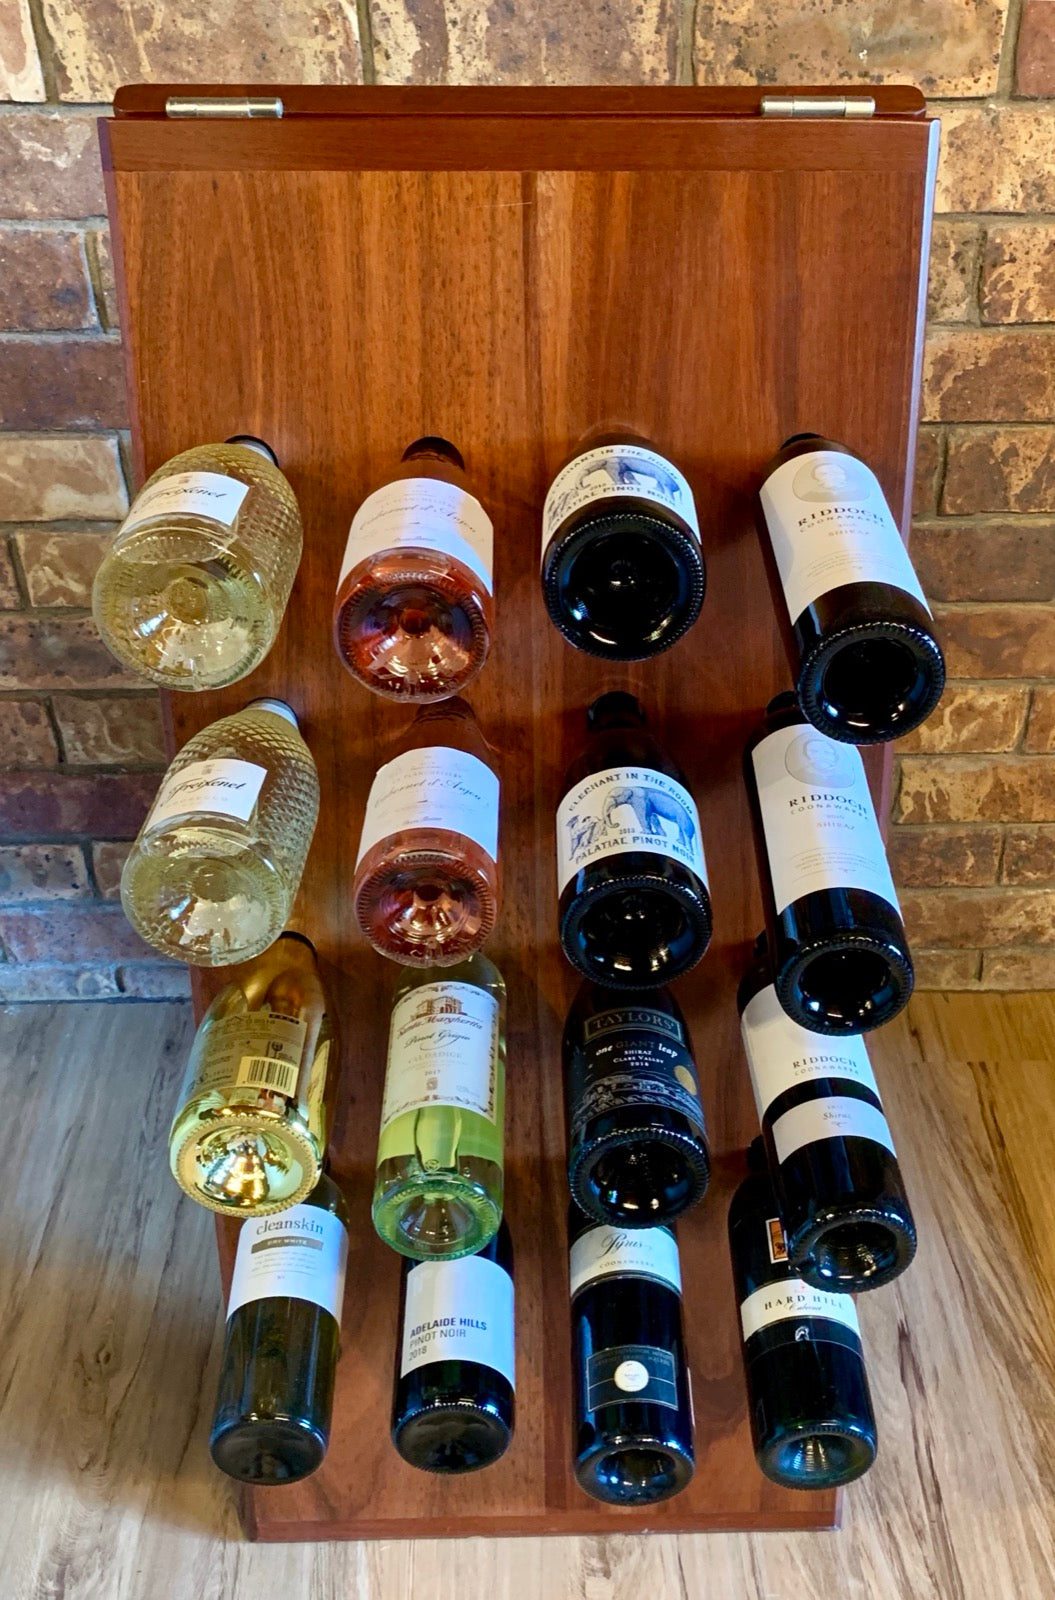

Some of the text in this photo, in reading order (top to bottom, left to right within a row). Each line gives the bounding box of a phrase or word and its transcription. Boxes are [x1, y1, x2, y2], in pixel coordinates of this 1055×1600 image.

[798, 507, 885, 528] RIDDOCH
[568, 772, 694, 815] ELEPHANT IN THE ROOM
[788, 794, 868, 815] RIDDOCH
[575, 836, 696, 866] PALATIAL PINOT NOIR
[792, 1055, 857, 1069] RIDDOCH
[255, 1217, 325, 1236] cleanskin
[764, 1295, 807, 1311] HARD
[408, 1328, 467, 1350] PINOT NOIR
[409, 1317, 488, 1340] ADELAIDE HILLS
[408, 1345, 428, 1361] 2018
